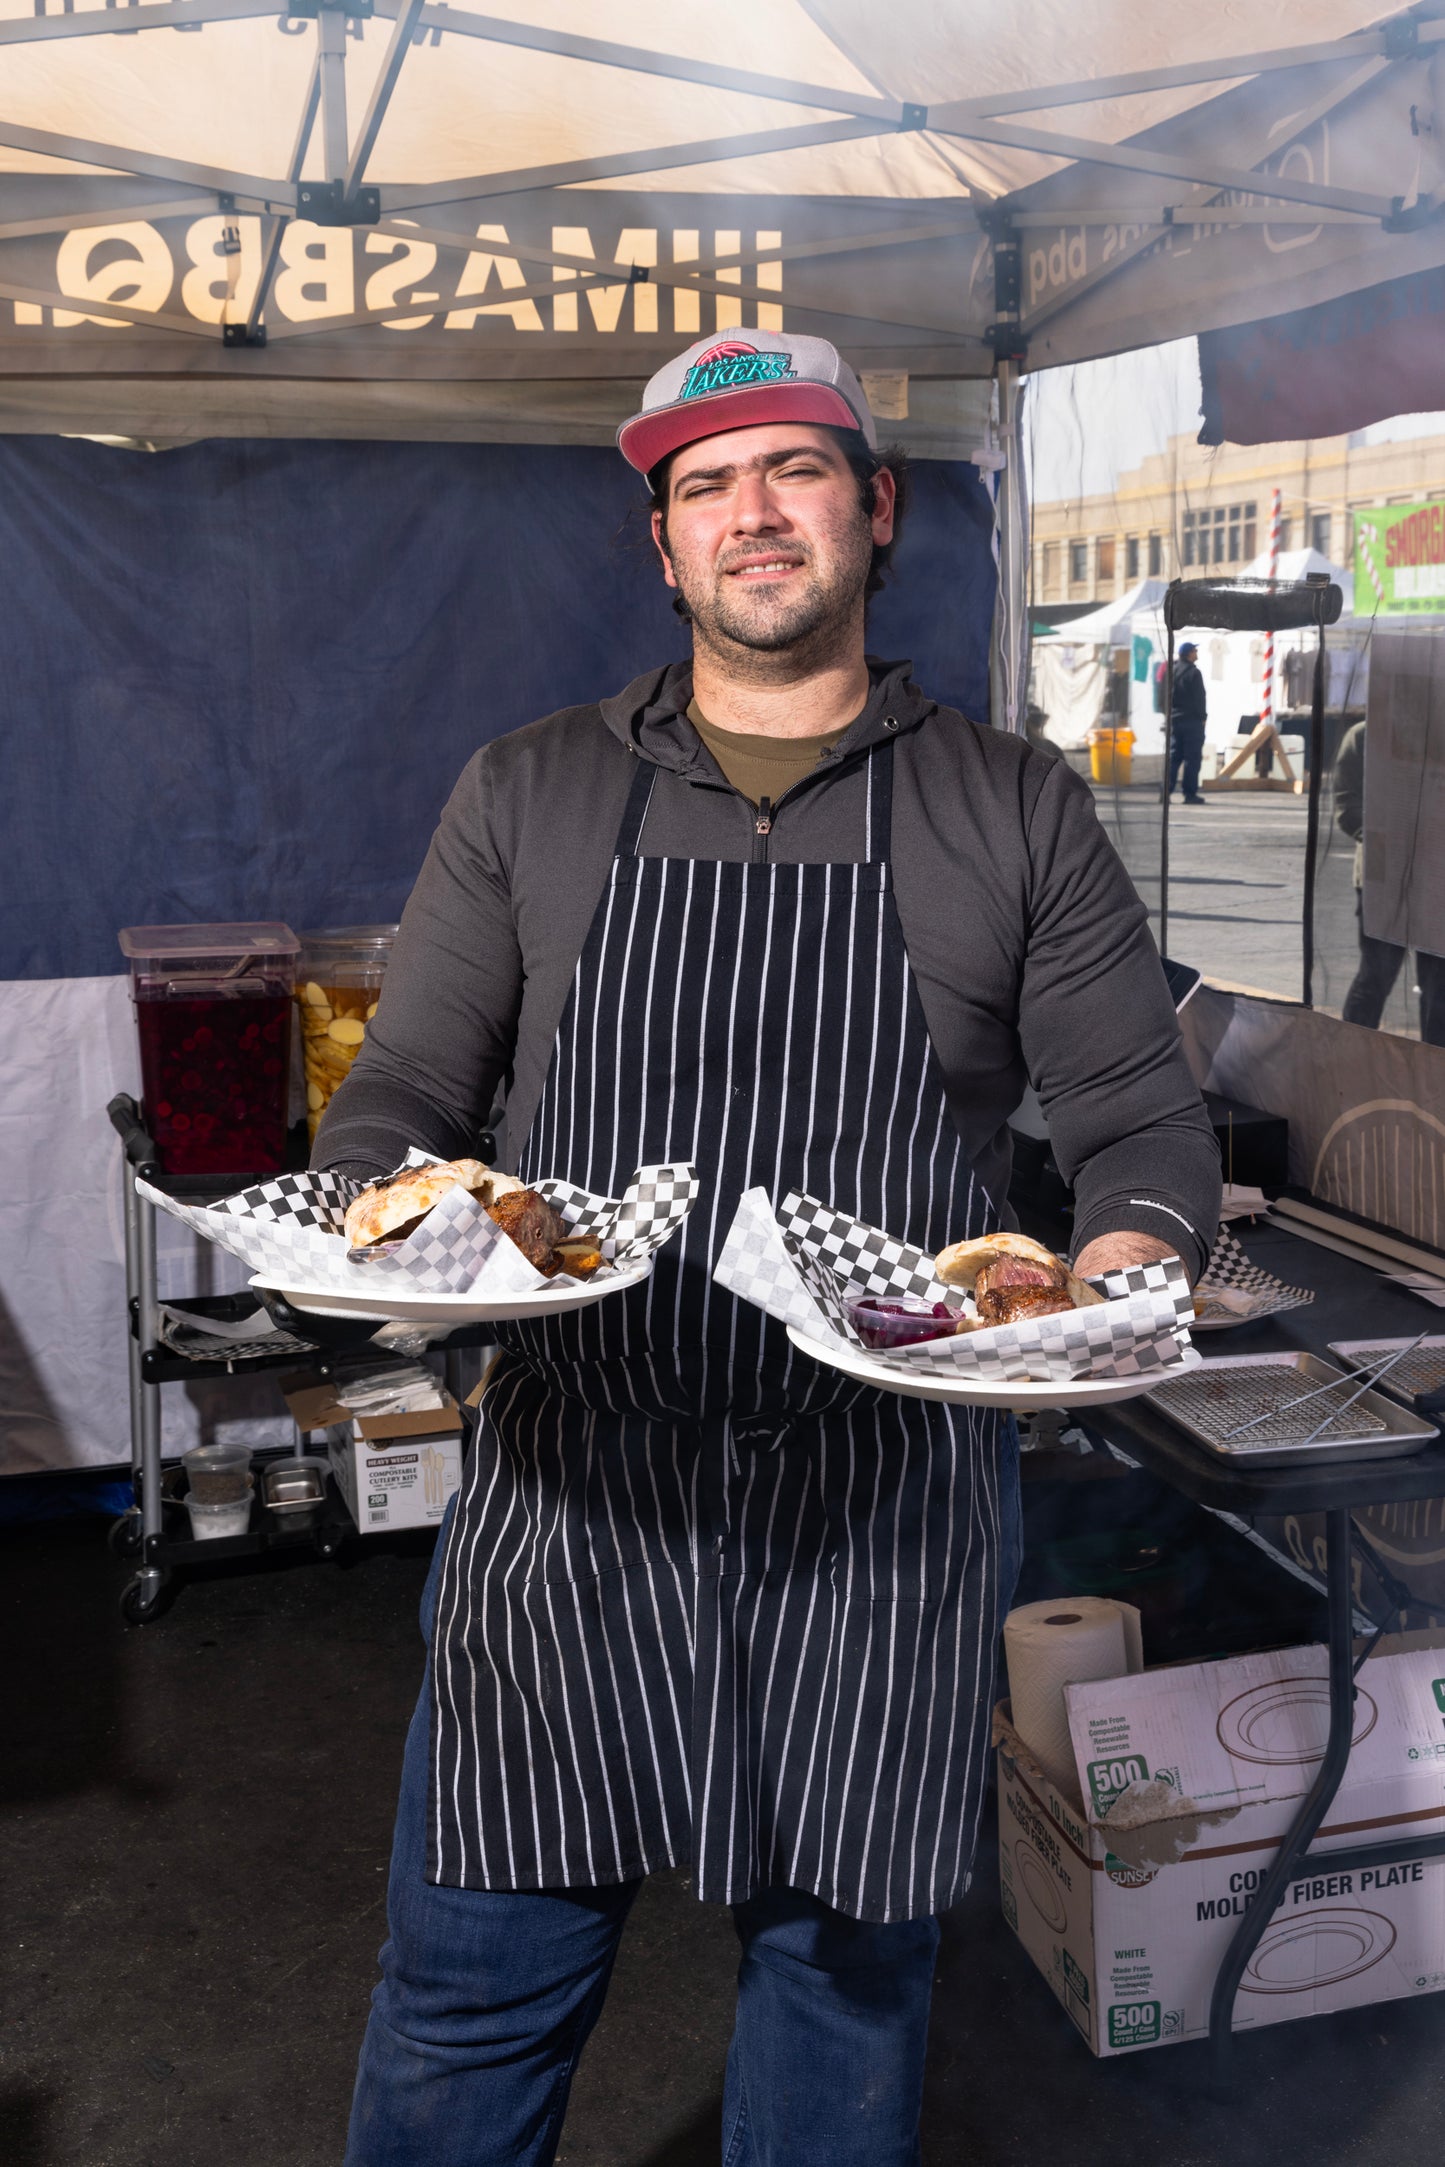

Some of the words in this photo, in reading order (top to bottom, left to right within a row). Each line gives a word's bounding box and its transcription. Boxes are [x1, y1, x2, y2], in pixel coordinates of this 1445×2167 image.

[708, 357, 729, 370] LOS
[683, 360, 789, 399] LAKERS
[368, 1457, 390, 1467] HEAVY
[391, 1454, 418, 1464] WEIGHT
[369, 1467, 417, 1478] COMPOSTABLE
[369, 1476, 400, 1485] CUTLERY
[402, 1473, 418, 1481] KITS
[370, 1495, 385, 1504] 200
[1089, 1719, 1107, 1728] Made
[1108, 1715, 1126, 1725] From
[1088, 1724, 1130, 1737] Compostable
[1093, 1733, 1129, 1745] Renewable
[1096, 1742, 1130, 1754] Resources
[1093, 1759, 1142, 1792] 500
[1049, 1795, 1060, 1821] 10
[1031, 1828, 1050, 1865] FIBER
[1051, 1856, 1072, 1893] PLATE
[1293, 1875, 1352, 1905] FIBER
[1361, 1862, 1423, 1892] PLATE
[1114, 1948, 1147, 1960] WHITE
[1113, 1966, 1132, 1975] Made
[1133, 1965, 1151, 1973] From
[1110, 1972, 1153, 1983] Compostable
[1115, 1989, 1150, 1998] Resources
[1113, 2004, 1155, 2029] 500
[1113, 2027, 1133, 2037] Count
[1138, 2025, 1155, 2033] Case
[1135, 2032, 1156, 2042] Count
